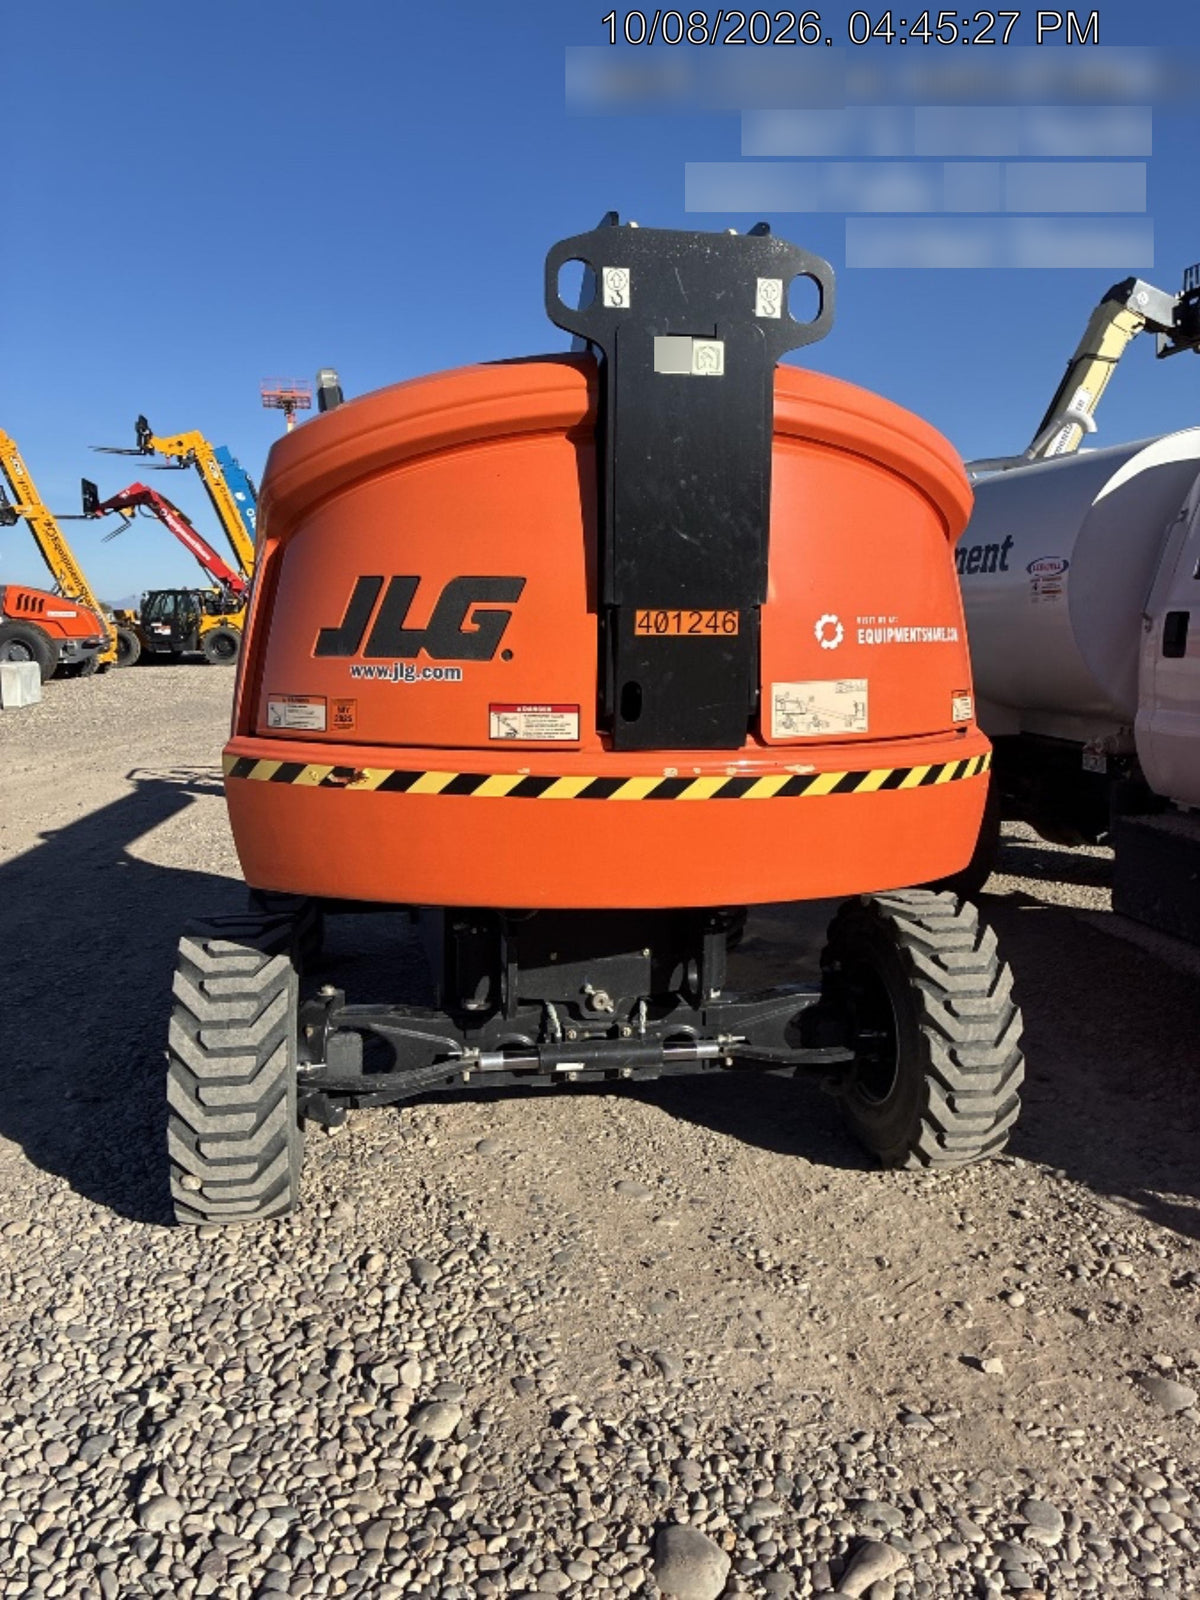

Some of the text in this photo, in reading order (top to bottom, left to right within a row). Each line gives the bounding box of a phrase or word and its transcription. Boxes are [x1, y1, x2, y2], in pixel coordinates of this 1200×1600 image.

[313, 576, 526, 661] JLG
[637, 611, 738, 633] 401246
[349, 663, 462, 682] www.jlg.com
